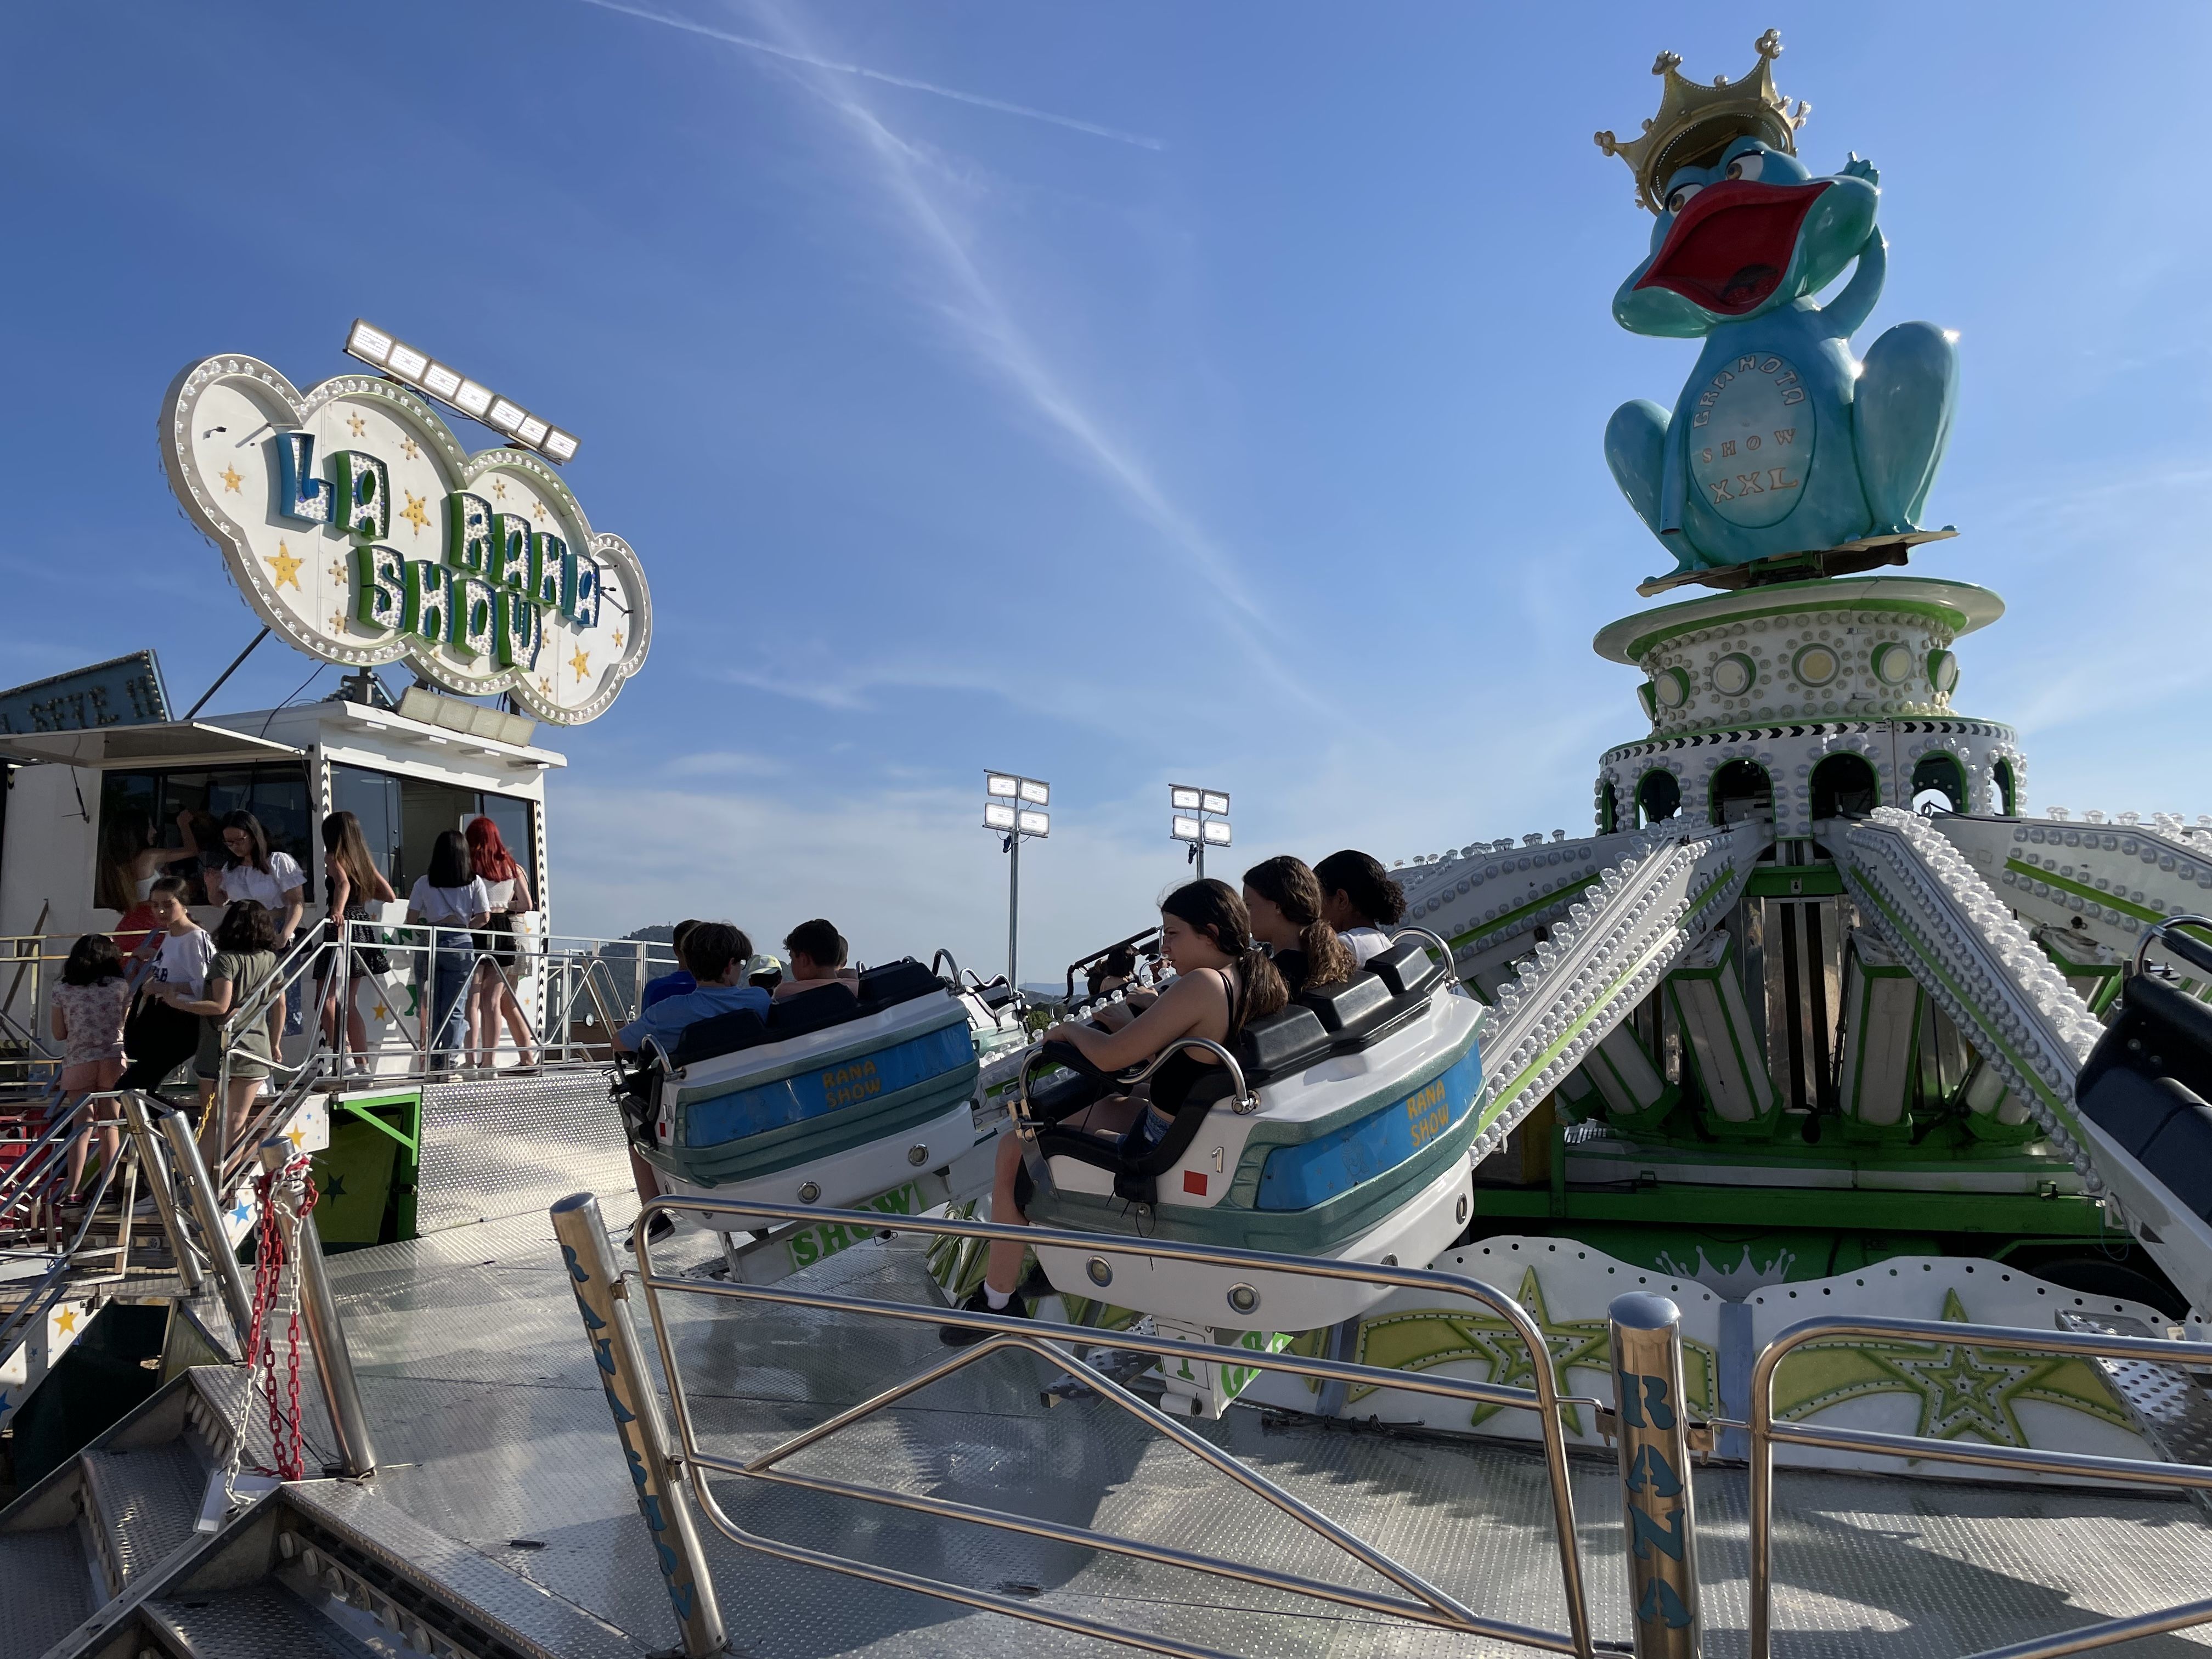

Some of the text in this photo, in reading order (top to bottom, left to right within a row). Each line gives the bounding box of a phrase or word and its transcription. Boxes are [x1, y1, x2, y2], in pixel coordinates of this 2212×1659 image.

[1693, 355, 1806, 430] GRANOTA
[1702, 428, 1796, 464] SHOW
[1709, 467, 1799, 504] XXL
[276, 432, 600, 628] LA RANA
[357, 544, 541, 672] SHOW
[822, 1059, 877, 1089] RANA
[826, 1077, 882, 1109] SHOW
[1406, 1079, 1446, 1120] RANA
[1410, 1103, 1449, 1147] SHOW
[1211, 1146, 1224, 1173] 1
[1618, 1368, 1693, 1629] RANA
